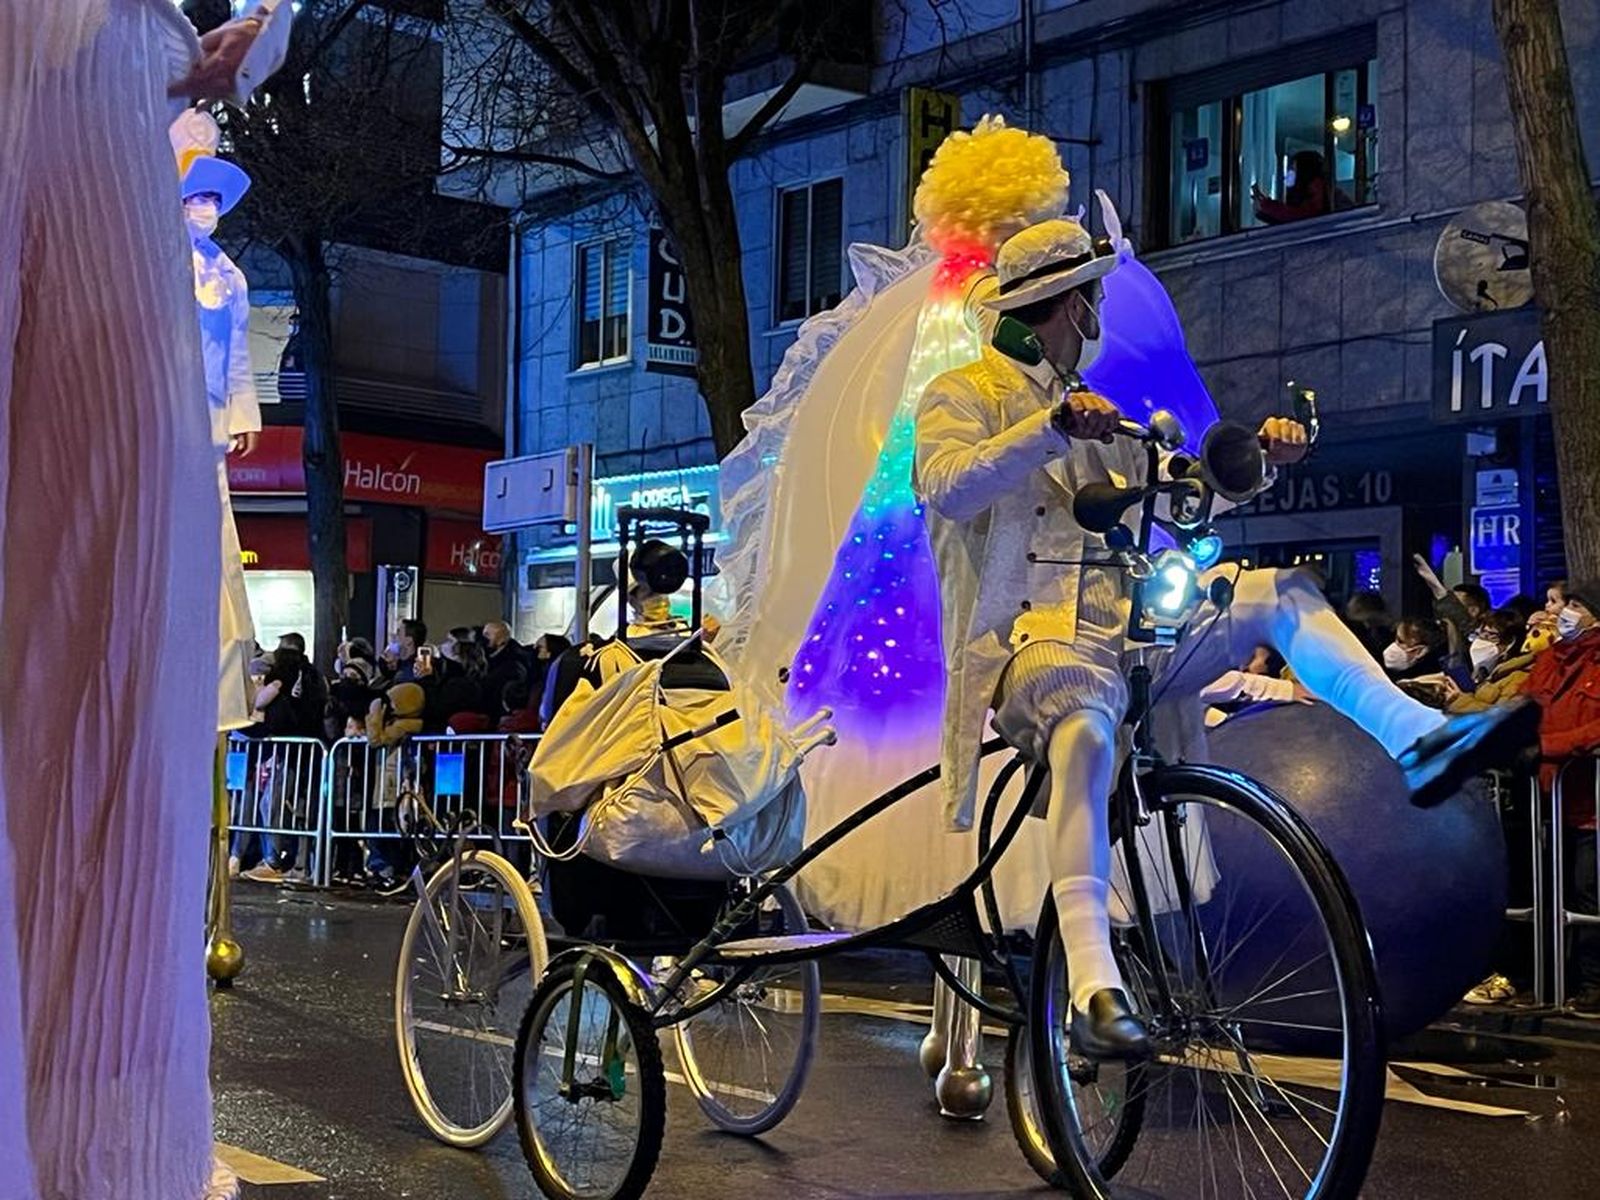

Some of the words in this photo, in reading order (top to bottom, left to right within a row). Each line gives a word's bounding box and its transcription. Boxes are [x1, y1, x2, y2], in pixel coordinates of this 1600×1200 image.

[344, 452, 420, 494] Halcón
[1238, 474, 1340, 513] EJAS
[1358, 470, 1392, 504] 10
